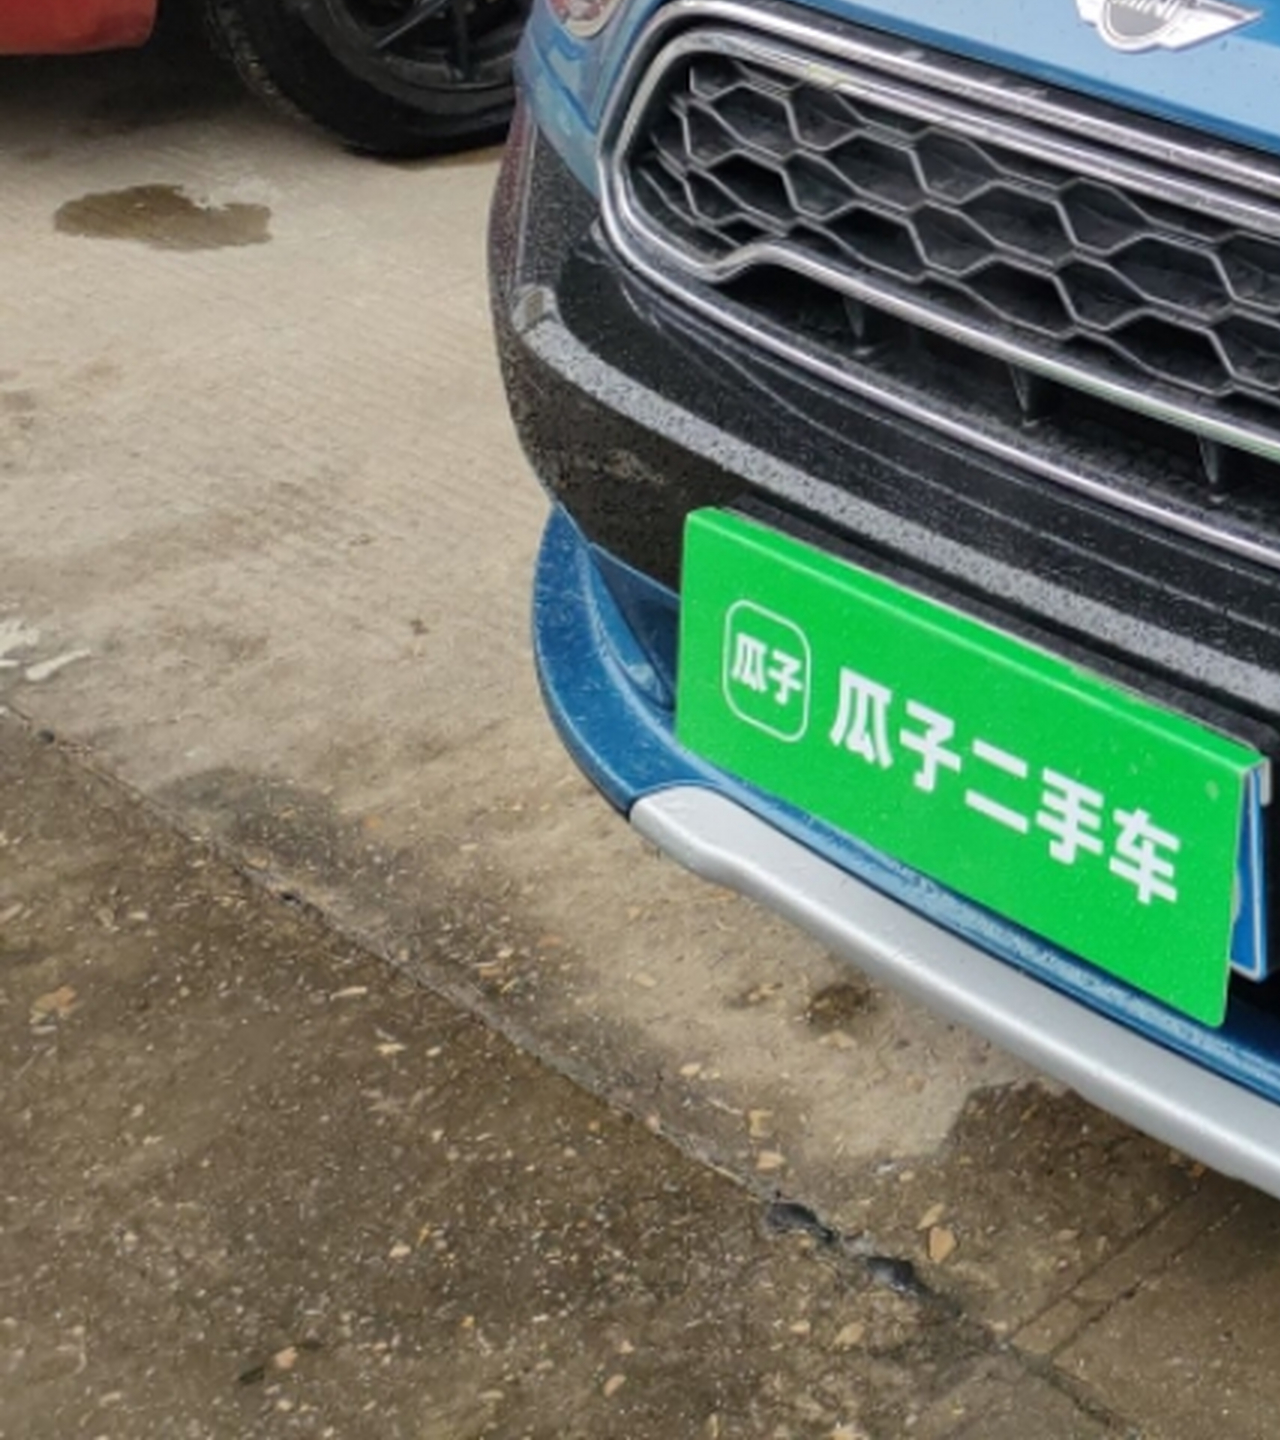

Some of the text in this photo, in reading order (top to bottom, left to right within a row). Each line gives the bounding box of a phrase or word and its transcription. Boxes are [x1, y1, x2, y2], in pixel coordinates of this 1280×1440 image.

[731, 632, 804, 706] 瓜子
[829, 667, 1182, 906] 瓜子二手车
